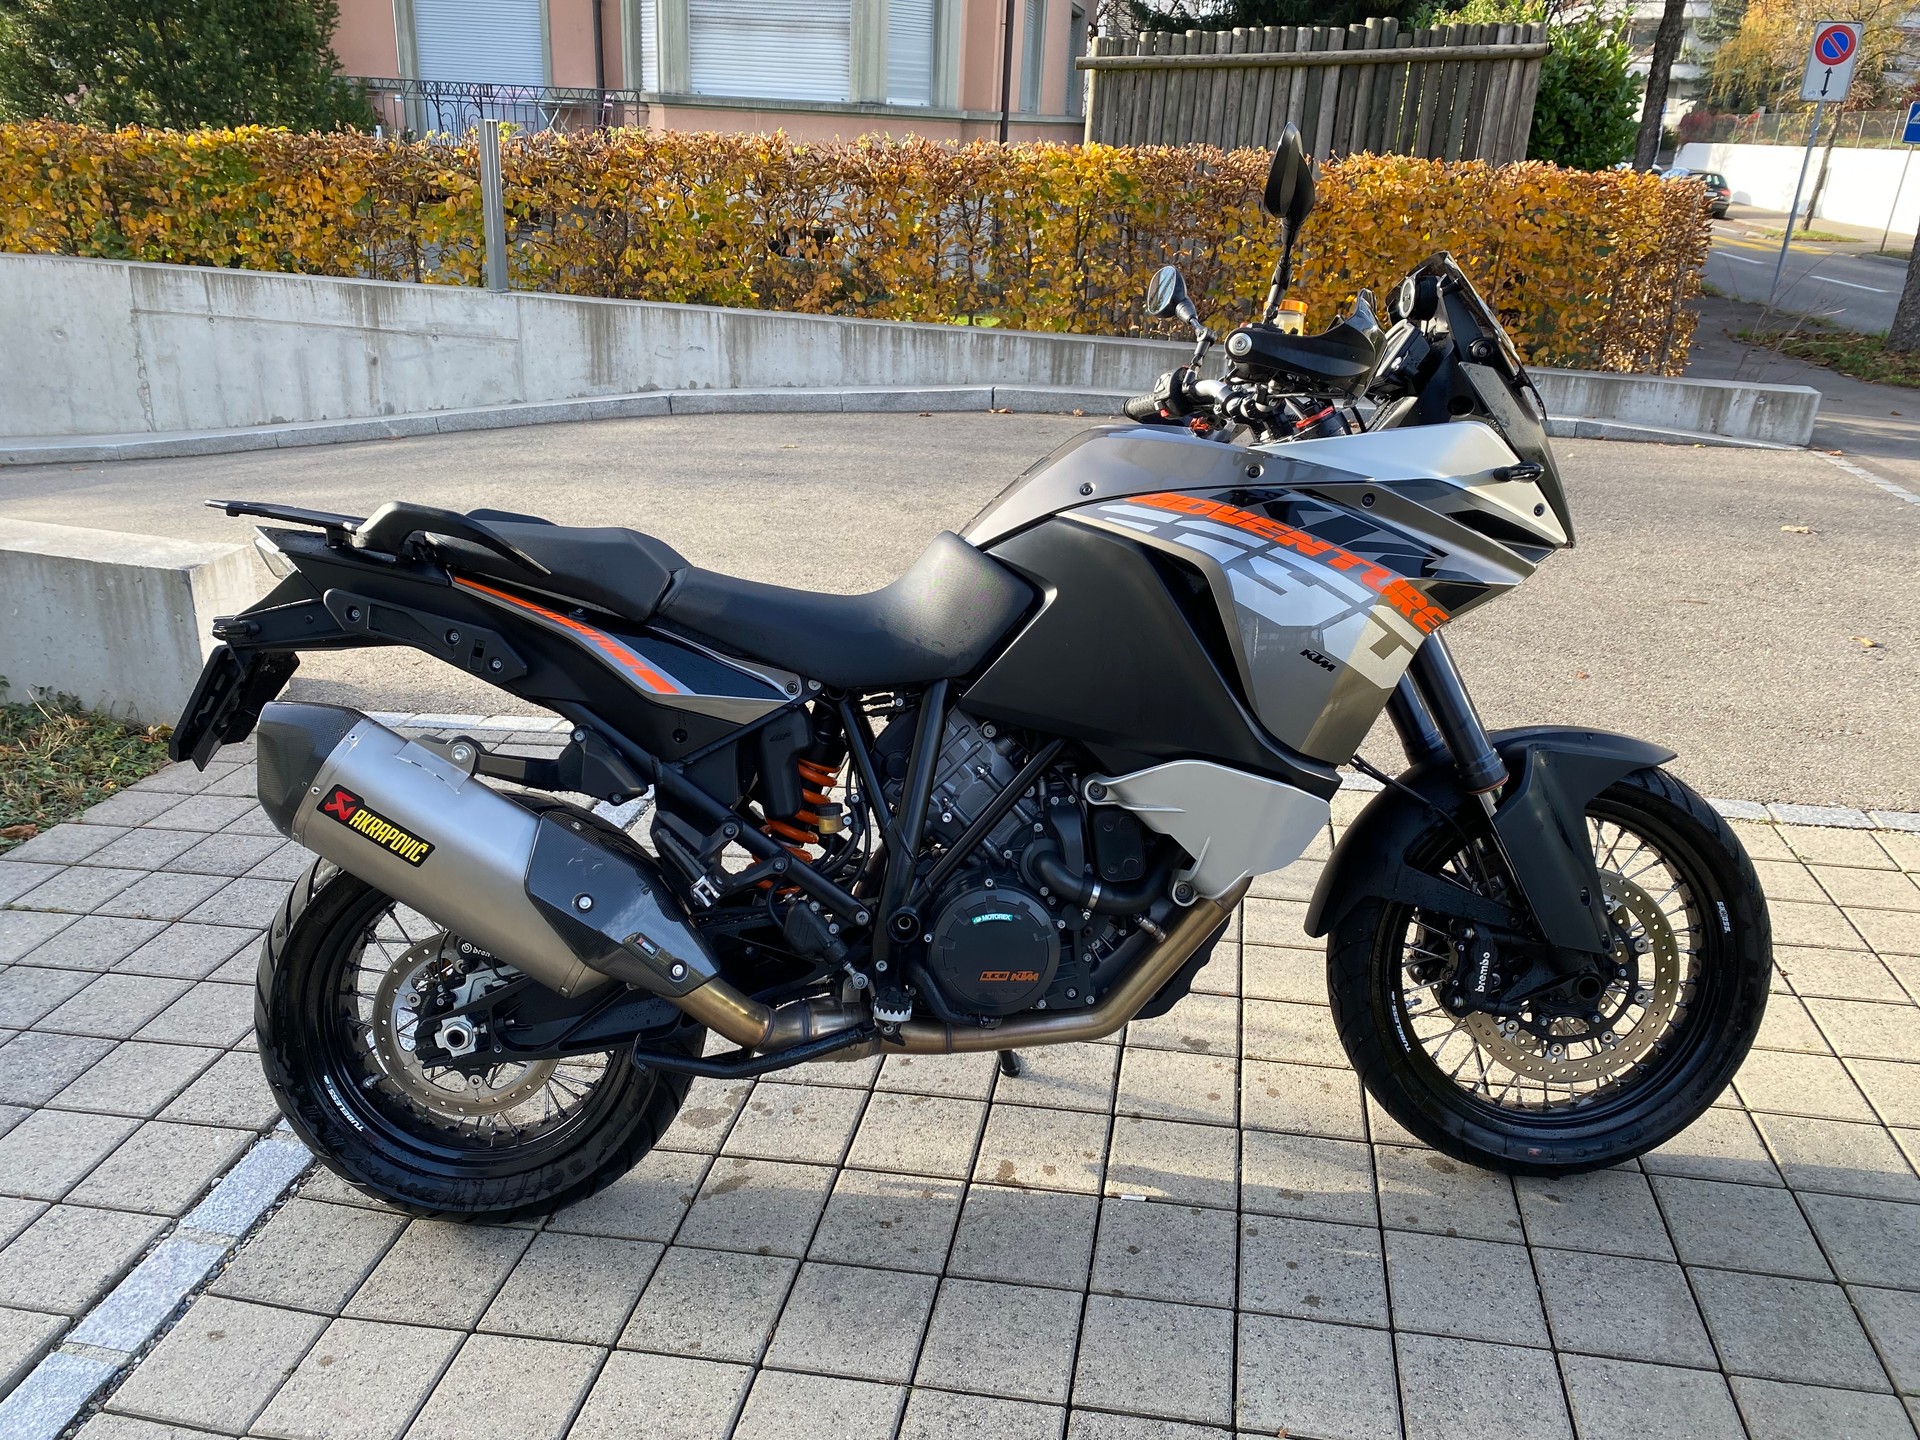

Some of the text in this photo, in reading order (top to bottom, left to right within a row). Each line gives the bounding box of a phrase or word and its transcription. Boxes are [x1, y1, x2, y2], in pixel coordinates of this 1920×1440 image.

[1124, 492, 1450, 634] ADVENTURE
[1300, 649, 1337, 672] KTM
[982, 913, 1011, 921] MOTOREX
[1010, 971, 1039, 981] KTM
[1474, 952, 1490, 992] brembo
[1392, 1004, 1411, 1052] TUBELESS
[328, 1089, 364, 1131] TUBELESS
